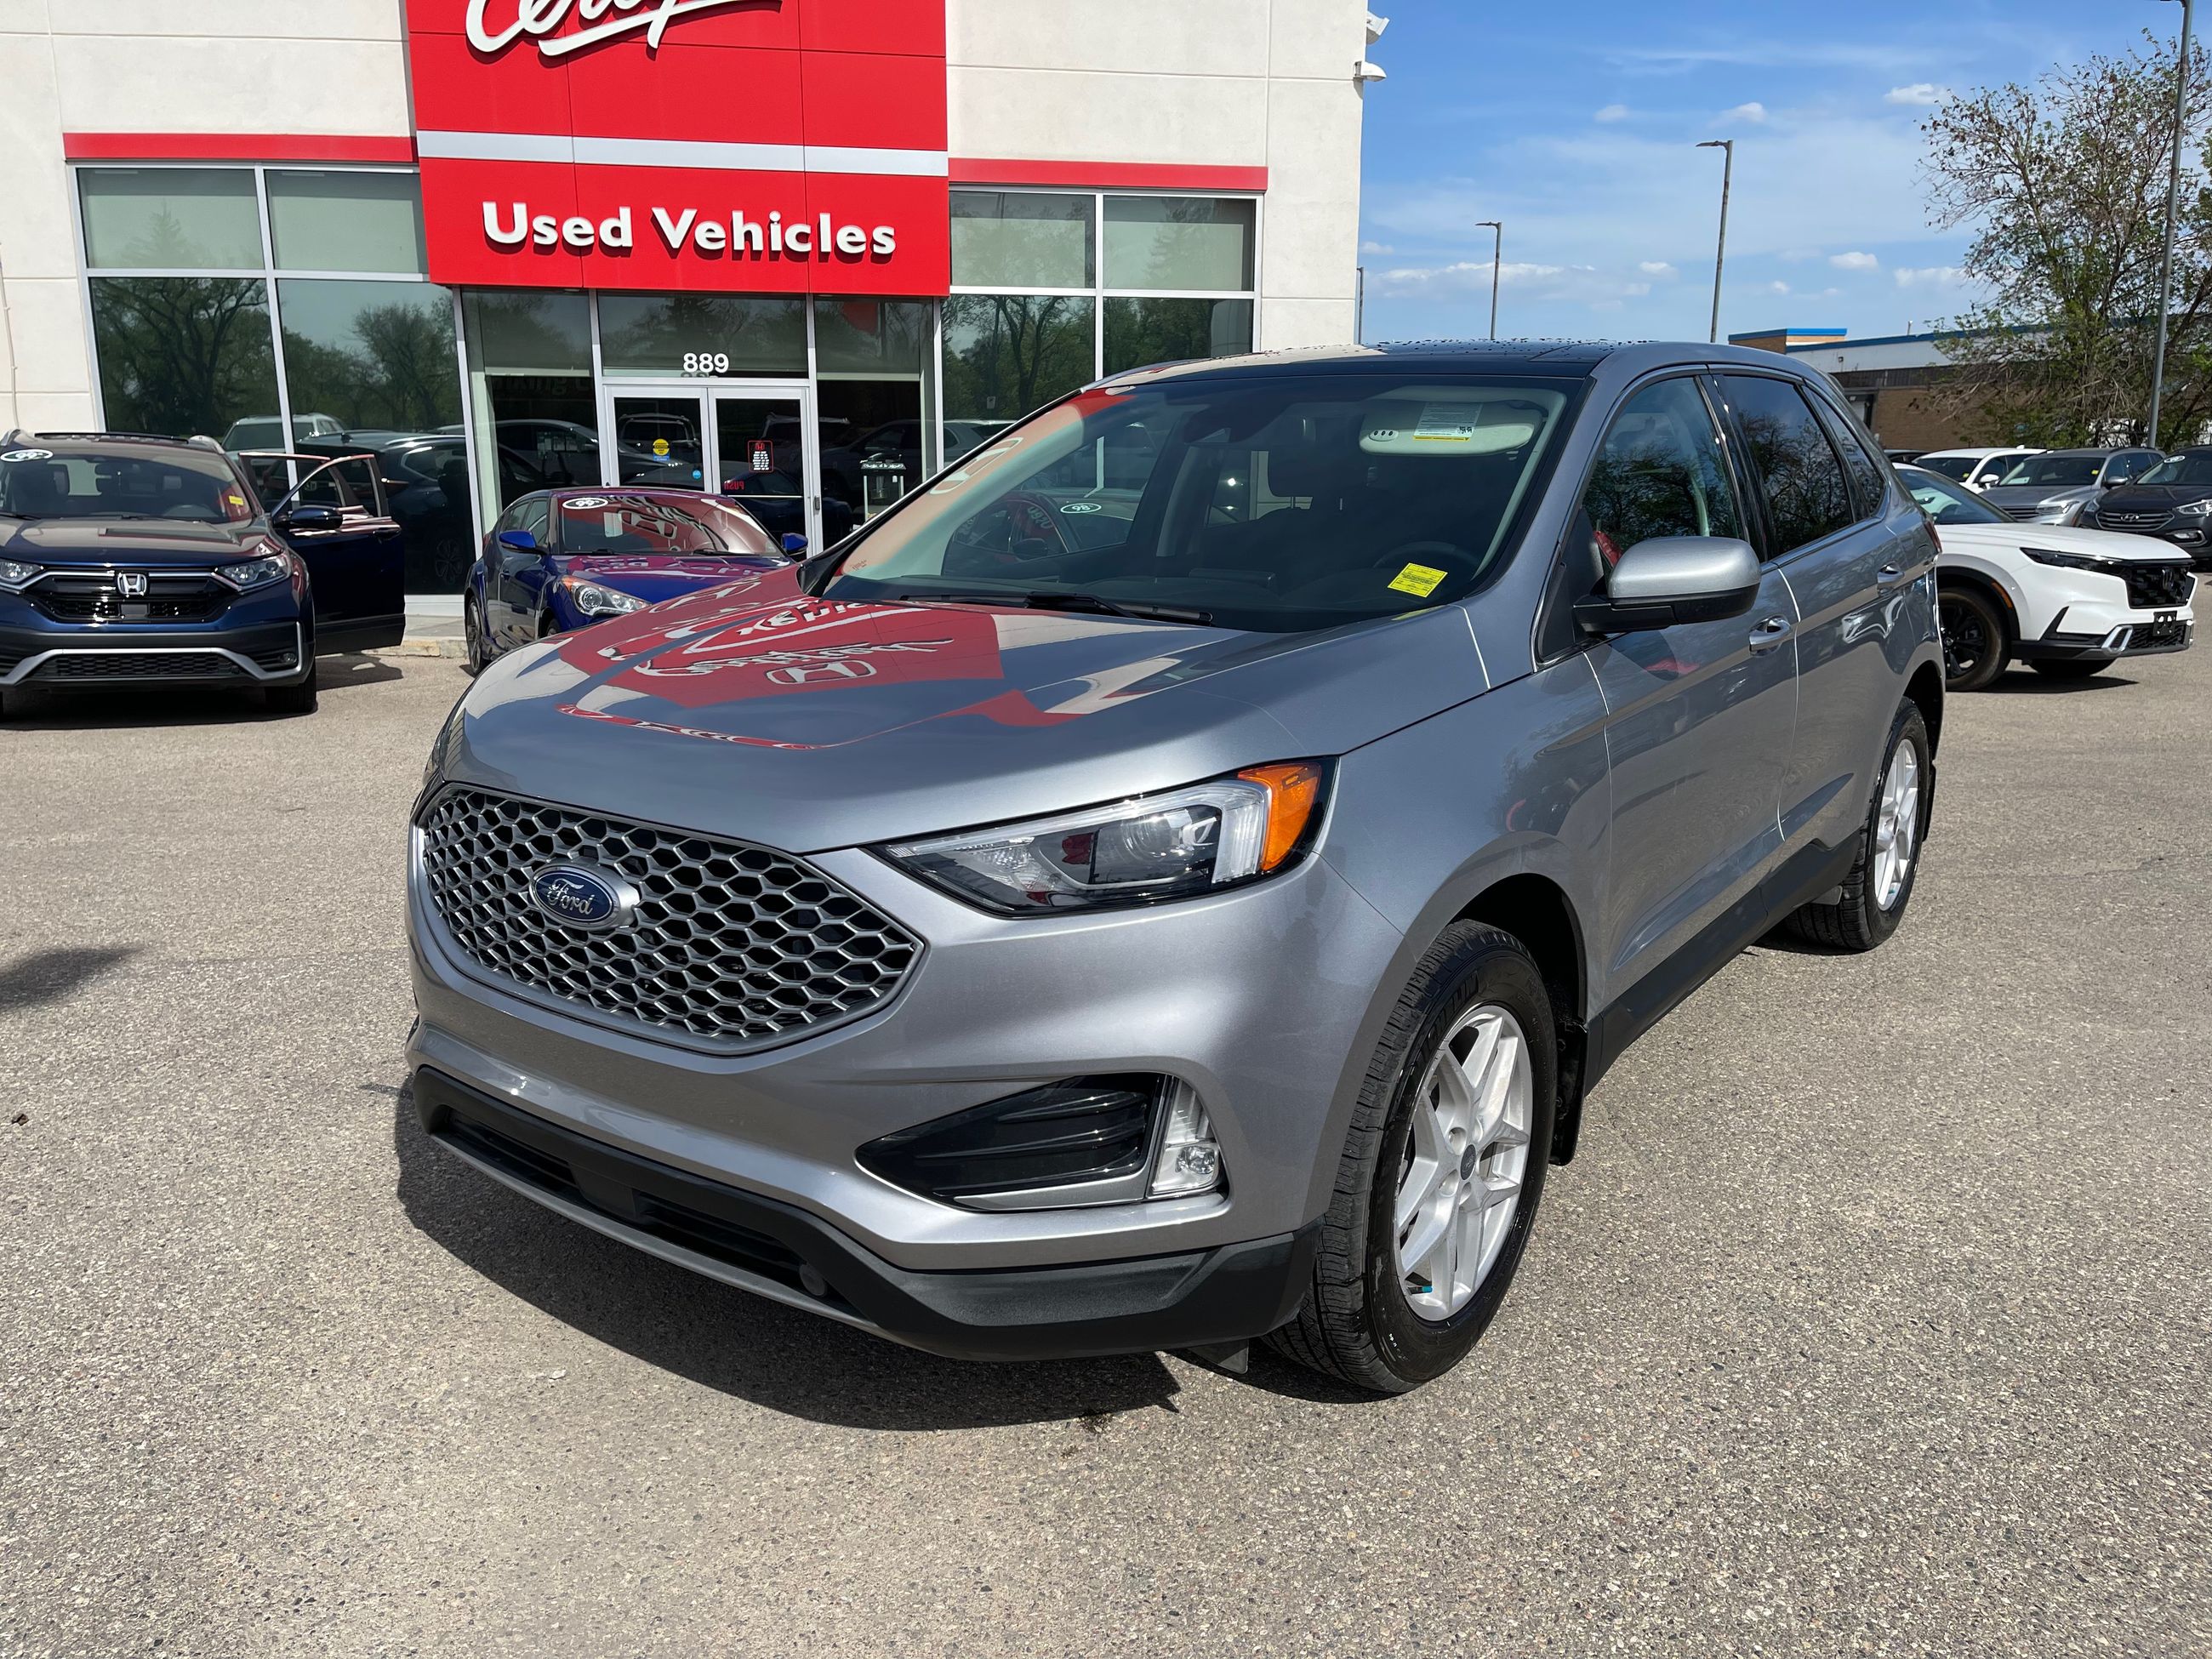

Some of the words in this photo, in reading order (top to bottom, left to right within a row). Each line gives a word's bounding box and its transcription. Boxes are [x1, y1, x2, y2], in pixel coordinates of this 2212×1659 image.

[482, 202, 633, 248] Used
[651, 207, 896, 254] Vehicles
[683, 352, 729, 373] 889
[546, 878, 596, 915] Ford
